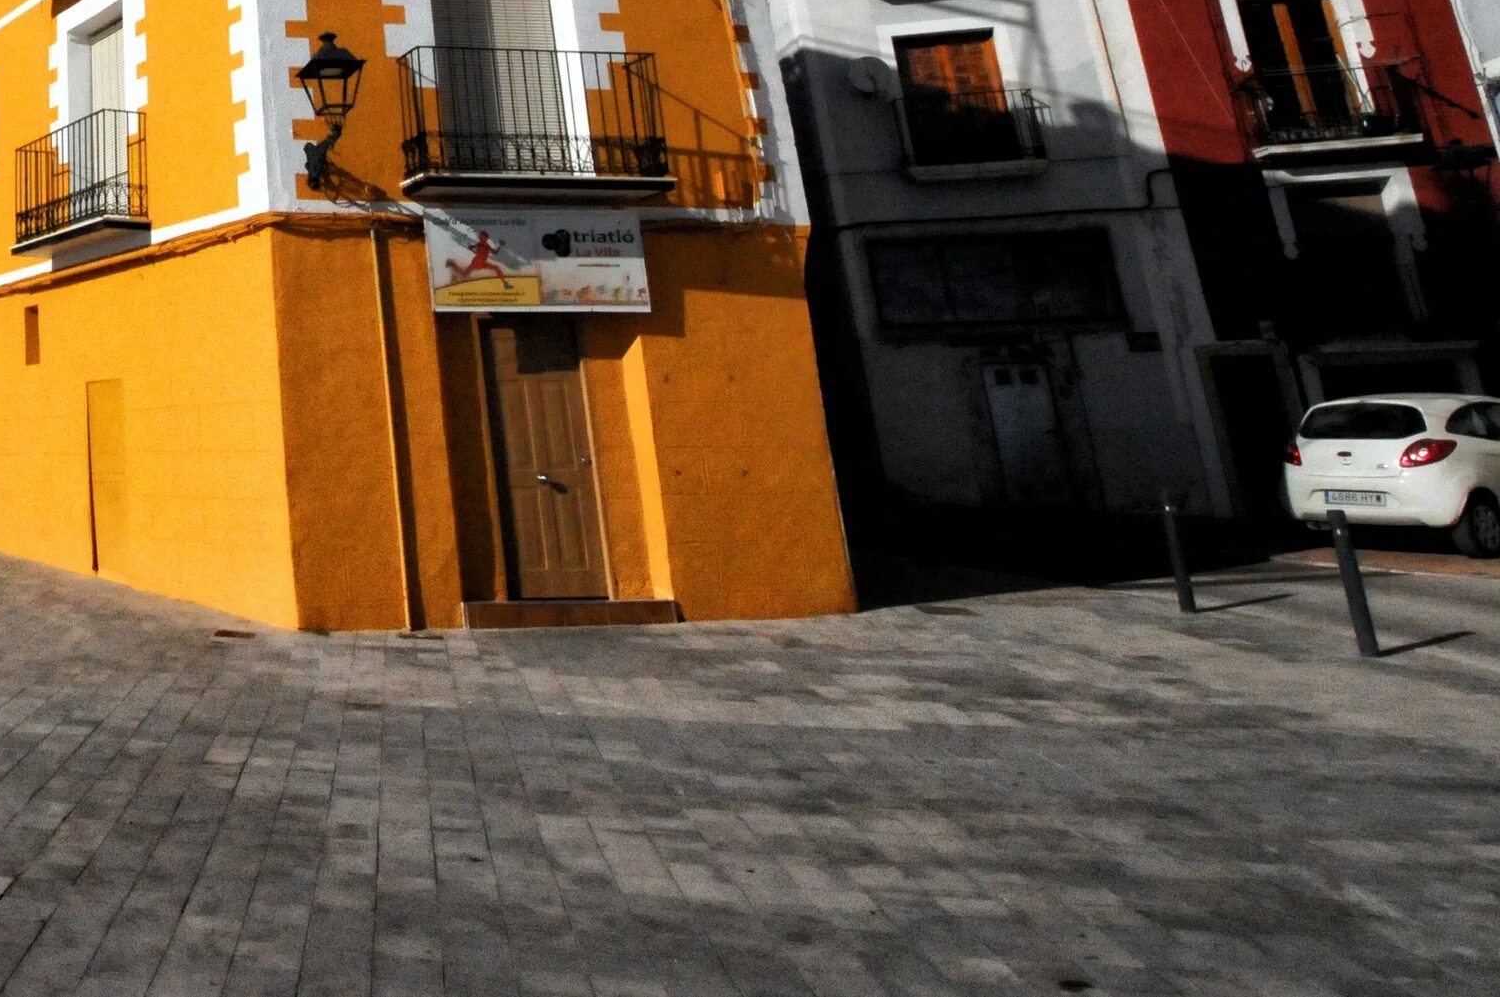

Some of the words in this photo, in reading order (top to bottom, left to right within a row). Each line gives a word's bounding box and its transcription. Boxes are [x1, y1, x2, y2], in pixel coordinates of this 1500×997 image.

[572, 229, 635, 244] triatló
[575, 247, 591, 257] La
[594, 246, 621, 257] Vila
